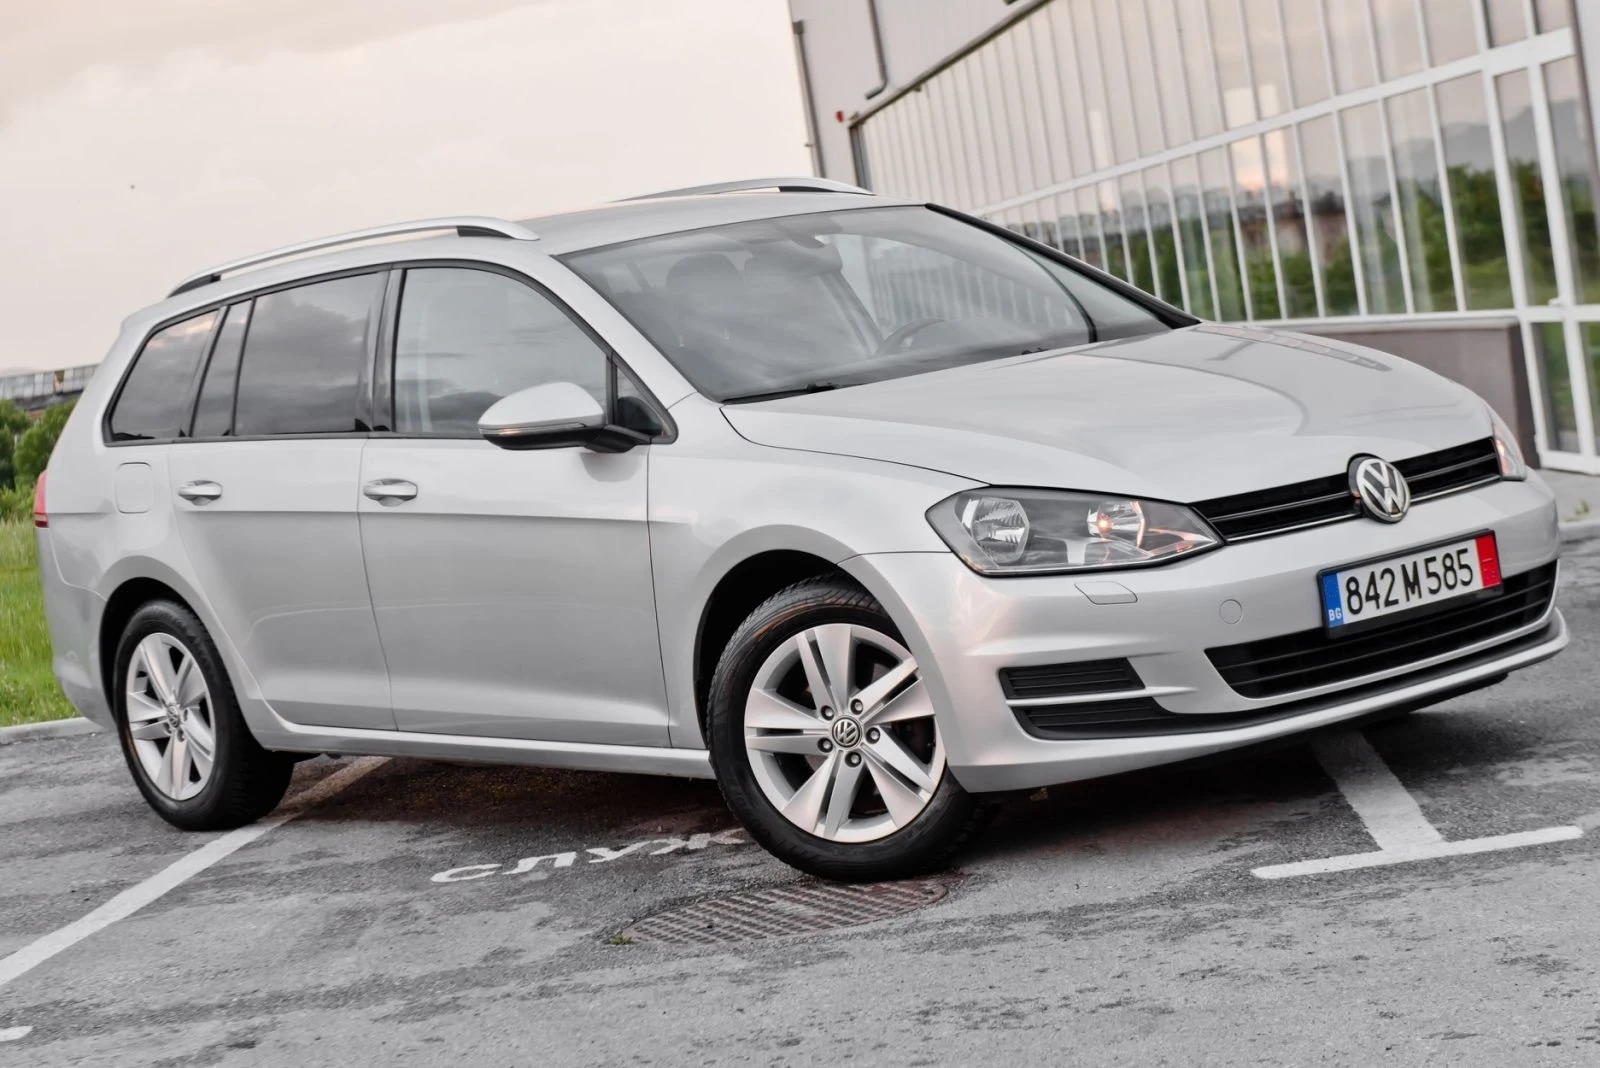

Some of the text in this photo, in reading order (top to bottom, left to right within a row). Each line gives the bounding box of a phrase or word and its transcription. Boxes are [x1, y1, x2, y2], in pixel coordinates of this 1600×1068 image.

[1357, 458, 1408, 519] VW
[1328, 607, 1342, 621] BG
[833, 719, 859, 746] VW
